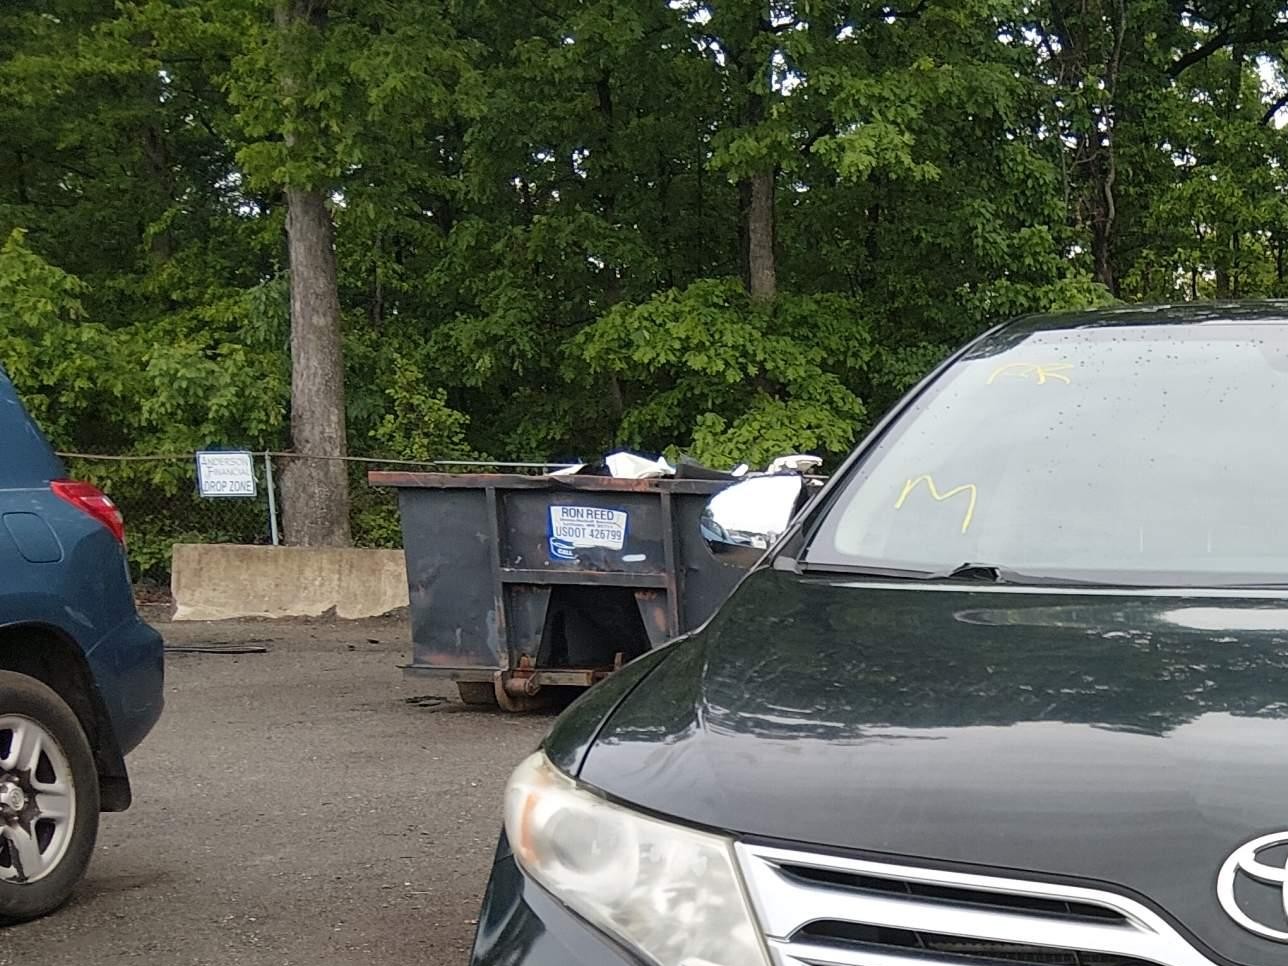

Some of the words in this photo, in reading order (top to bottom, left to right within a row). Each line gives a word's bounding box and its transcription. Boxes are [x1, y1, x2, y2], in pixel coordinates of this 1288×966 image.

[203, 479, 228, 492] DROP
[228, 479, 253, 492] ZONE
[894, 473, 977, 535] M
[561, 507, 584, 519] RON
[585, 508, 614, 521] REED
[556, 525, 586, 539] USDOT
[588, 528, 622, 542] 426799
